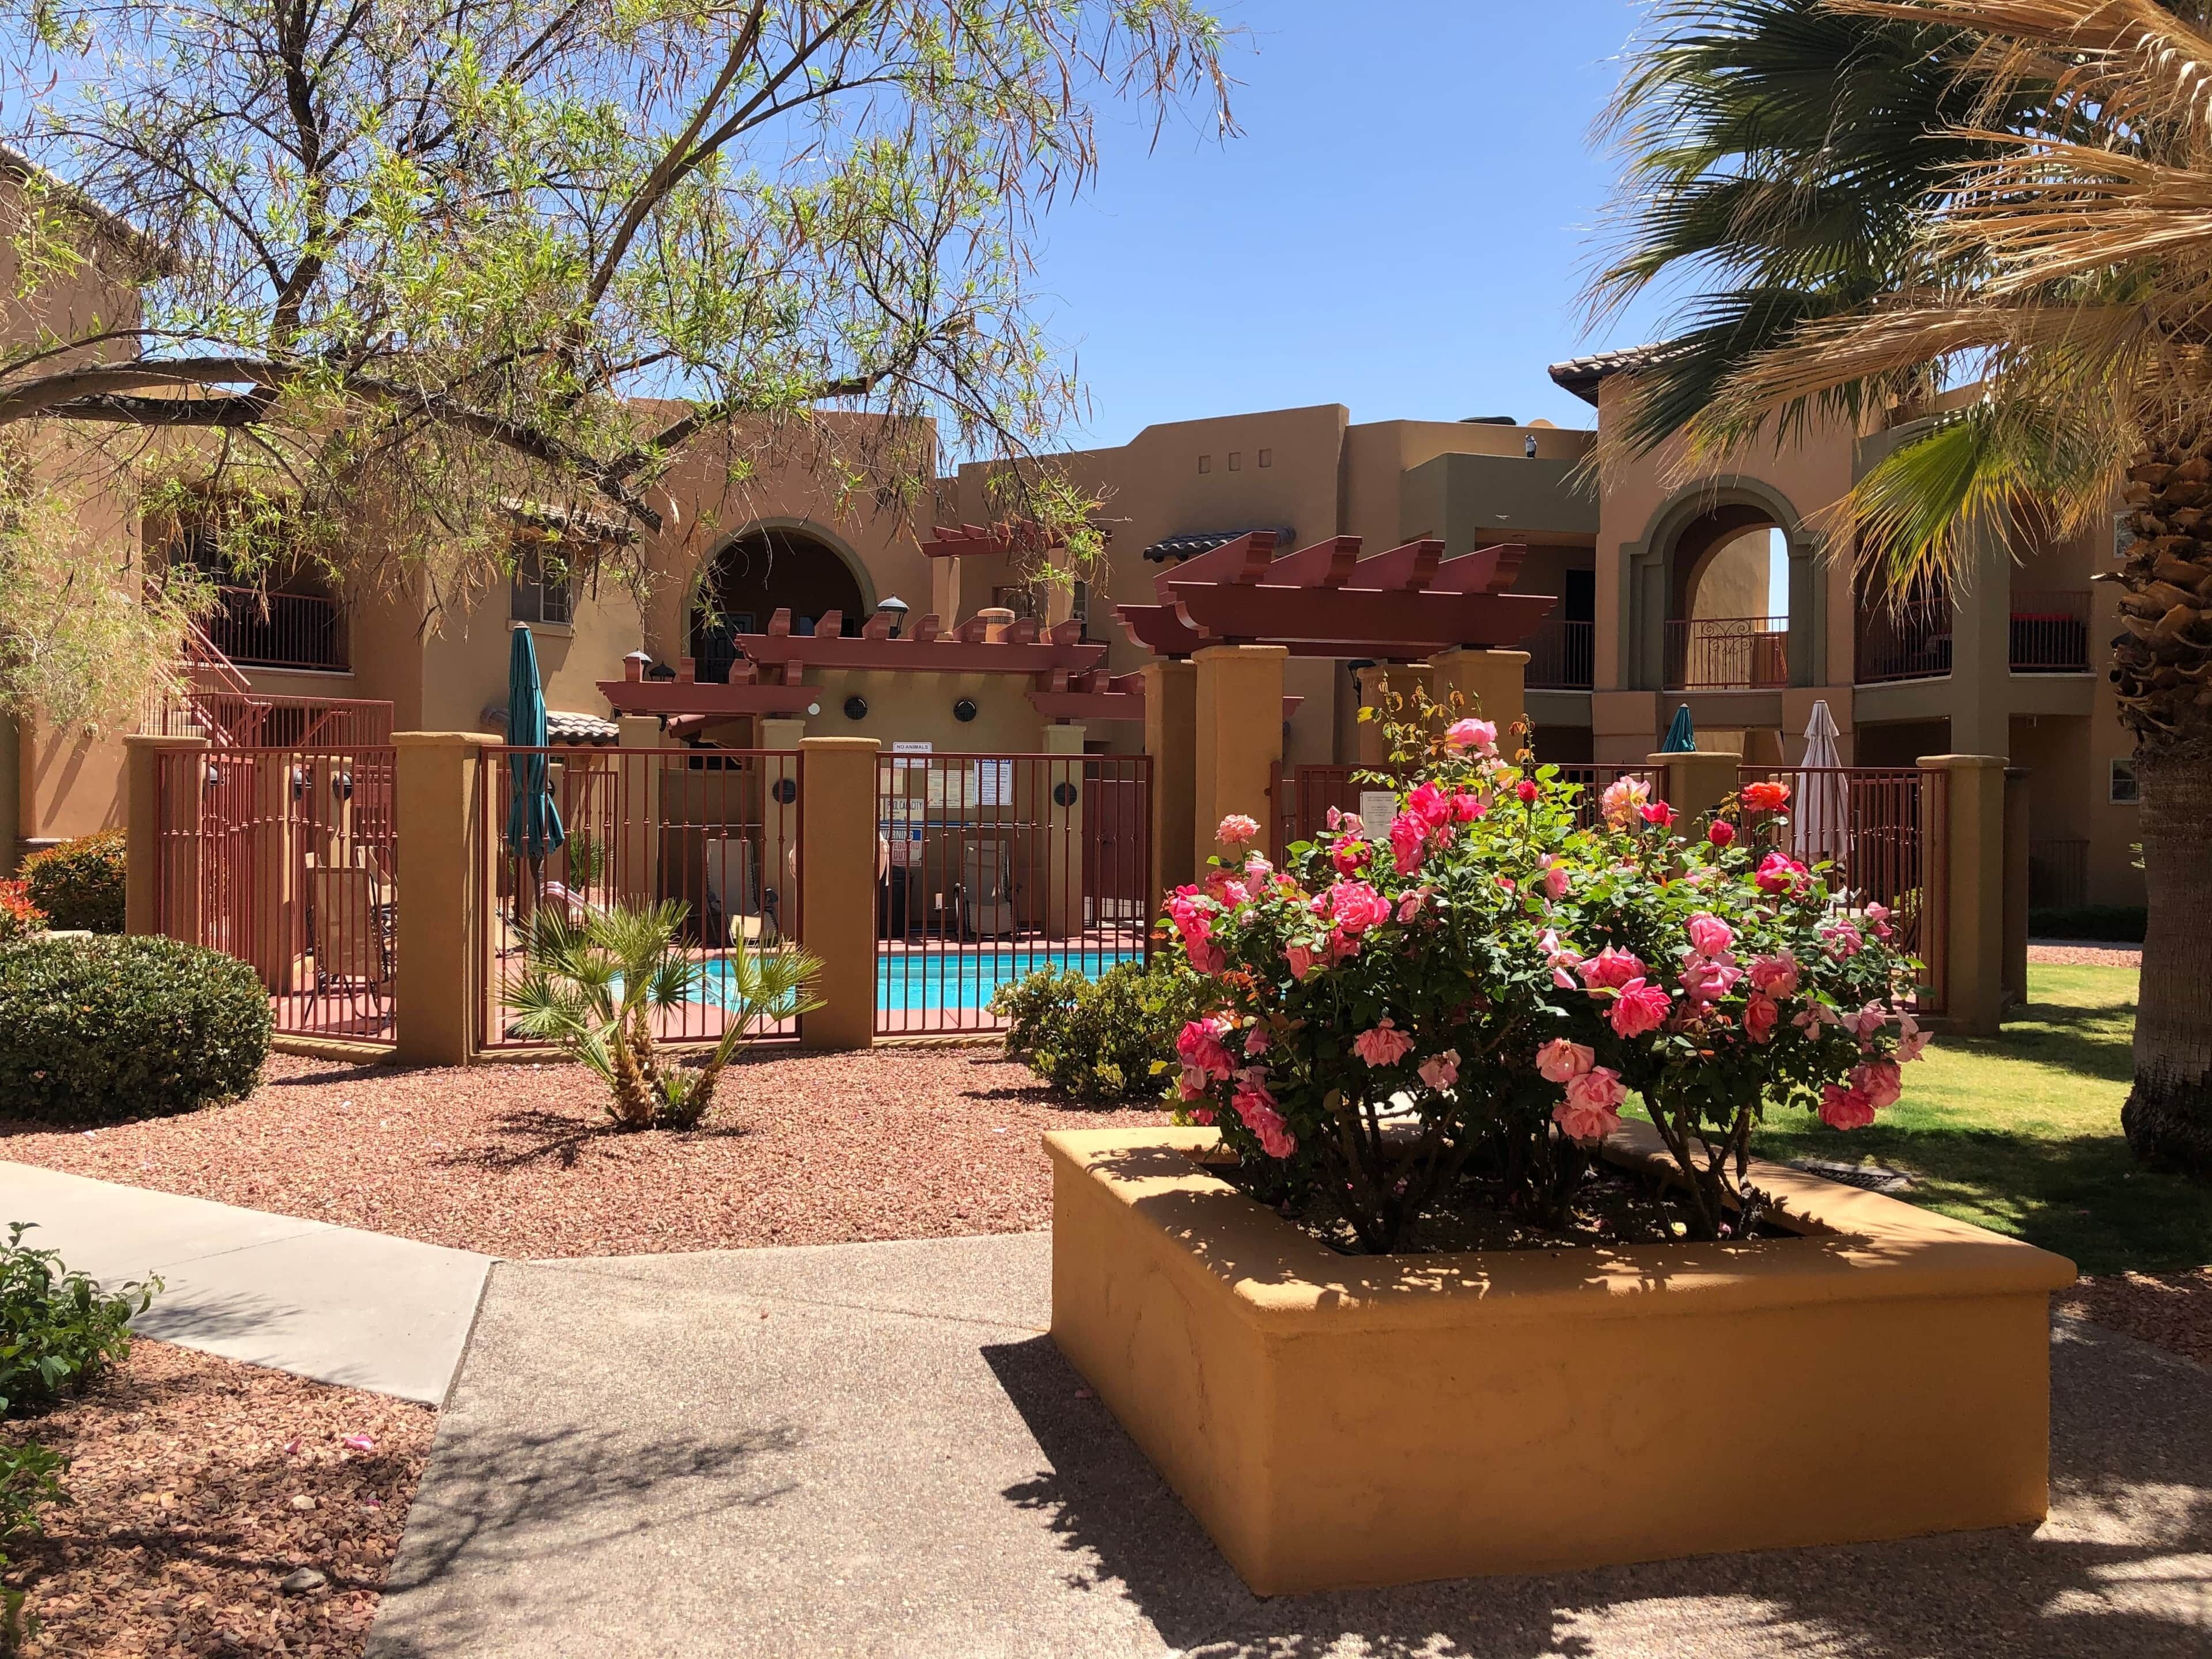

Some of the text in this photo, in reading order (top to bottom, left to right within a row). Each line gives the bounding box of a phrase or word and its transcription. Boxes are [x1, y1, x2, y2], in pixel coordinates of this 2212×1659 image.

[887, 801, 922, 810] POL CACITY
[893, 850, 910, 859] DUT
